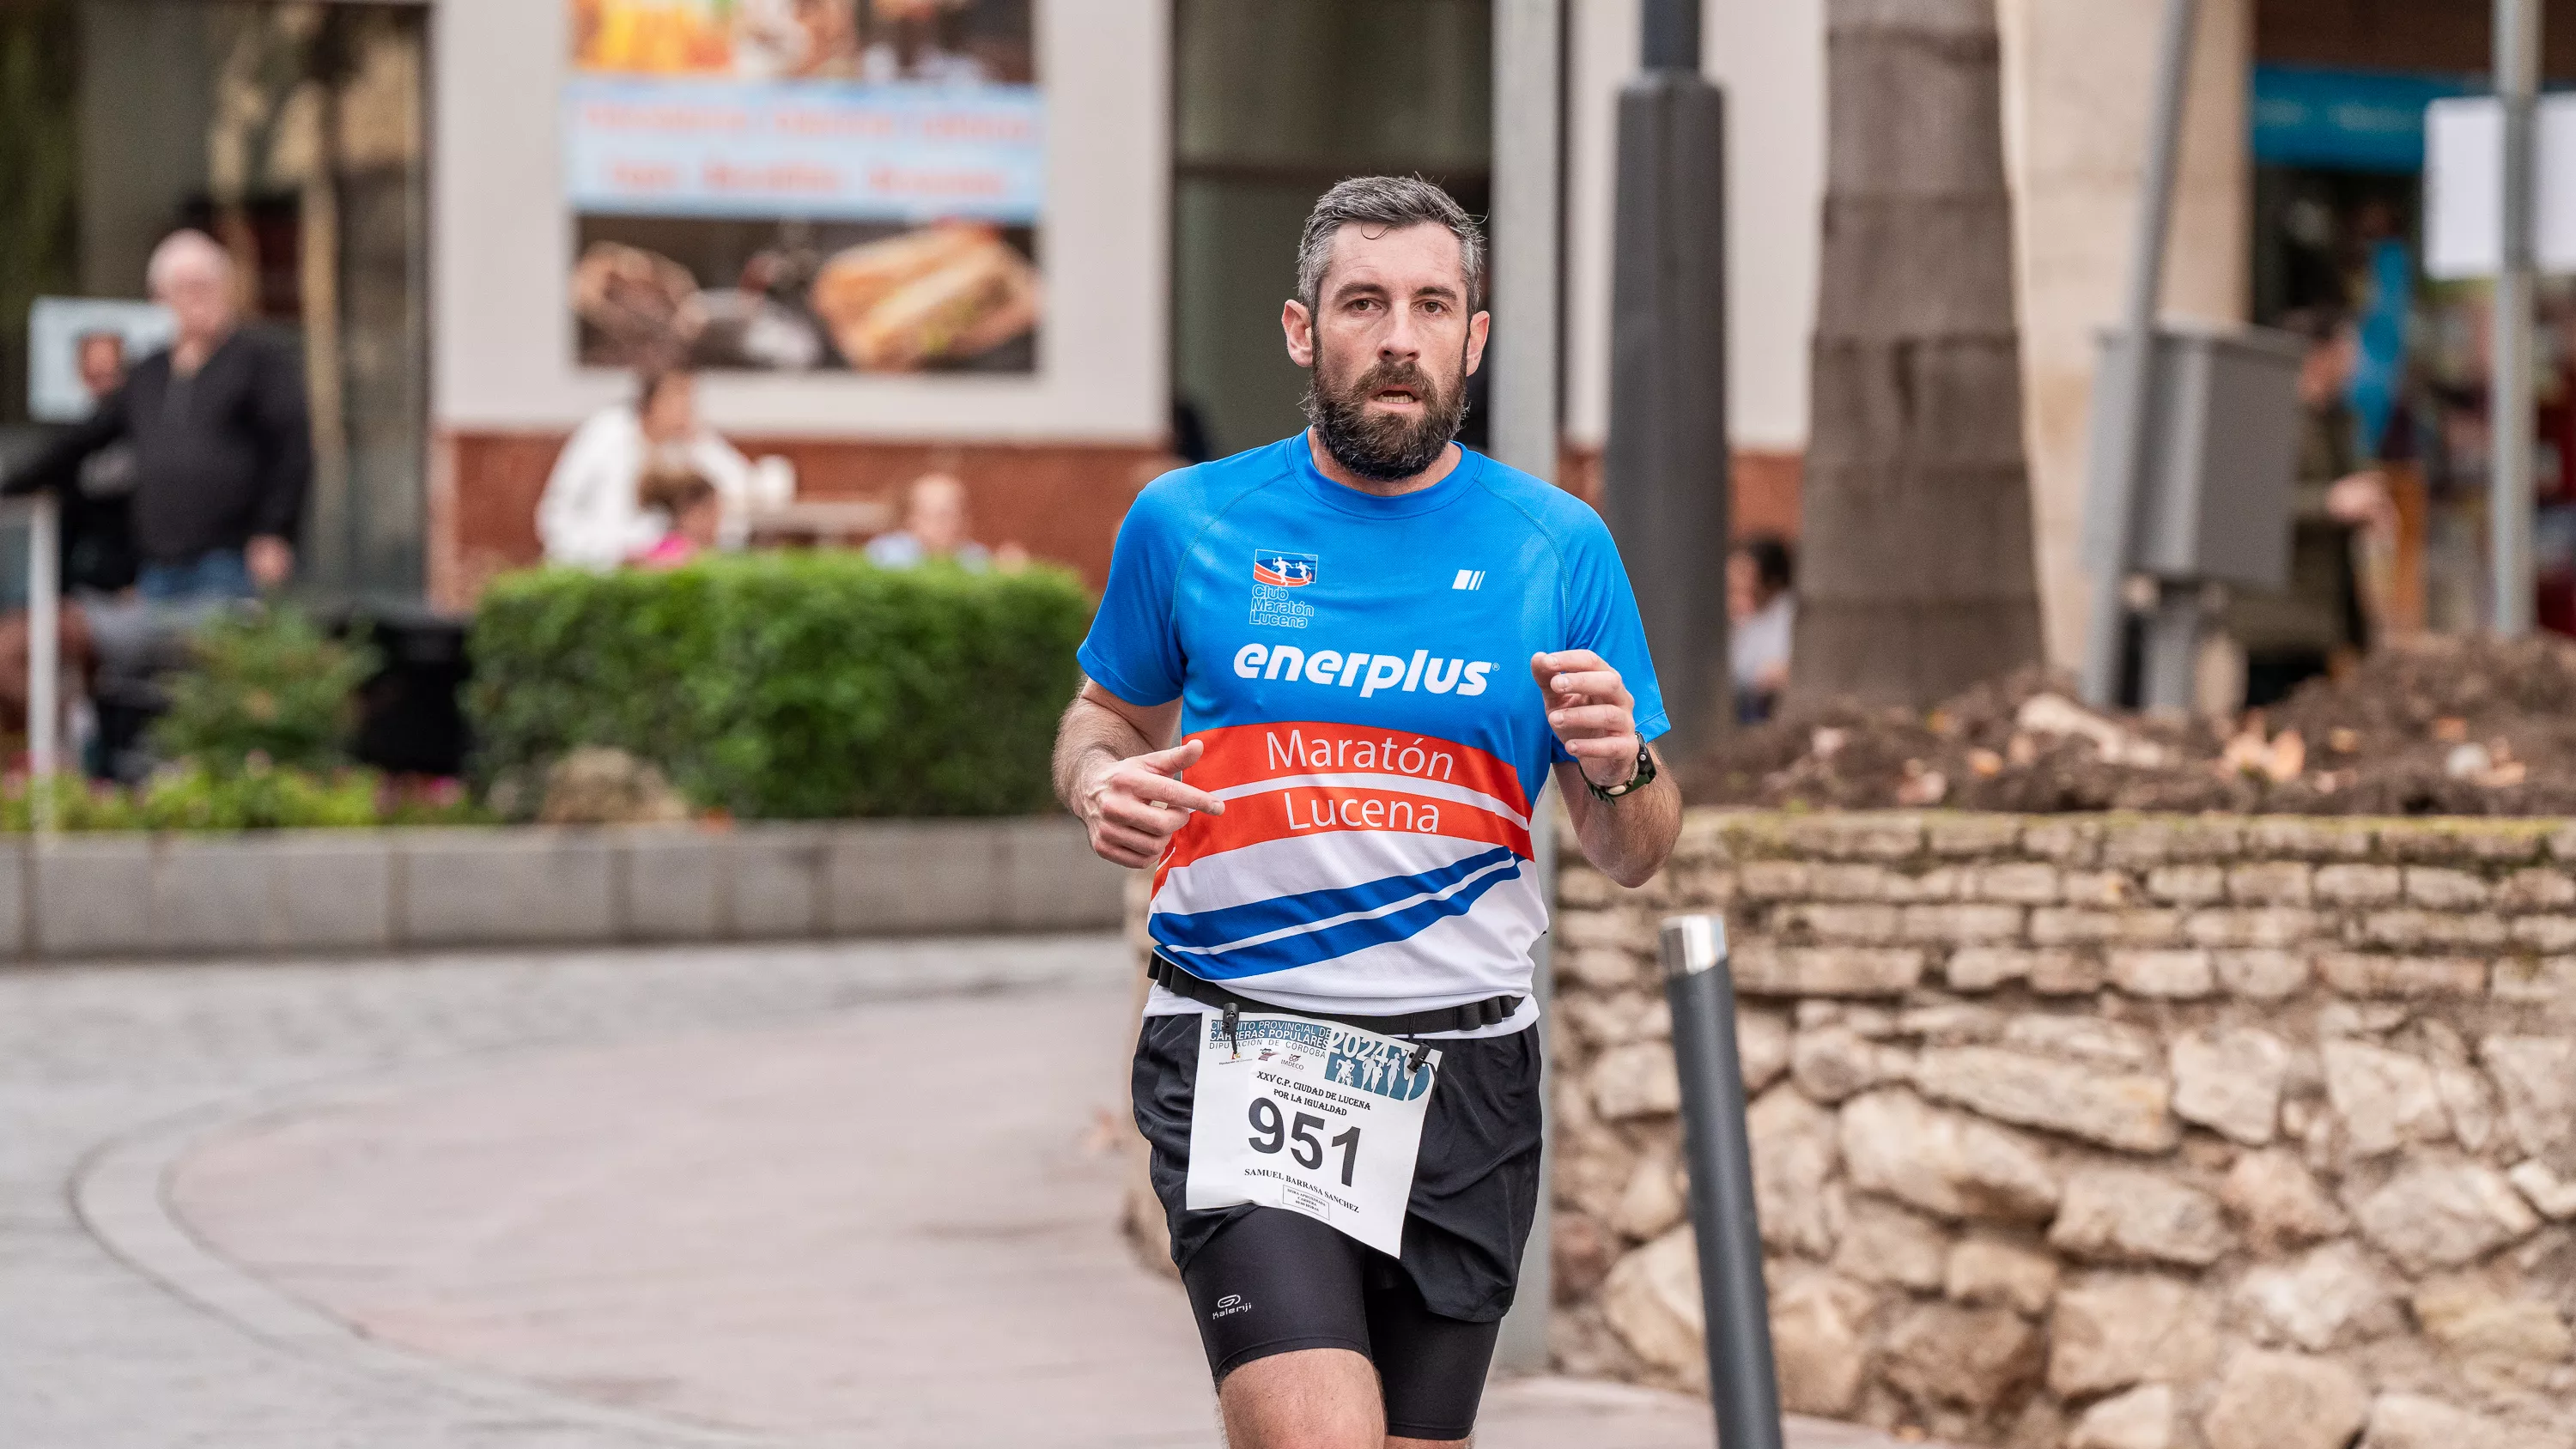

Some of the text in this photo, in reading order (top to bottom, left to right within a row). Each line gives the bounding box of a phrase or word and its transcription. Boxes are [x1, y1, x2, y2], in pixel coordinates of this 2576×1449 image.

[1250, 597, 1315, 616] Maratón
[1252, 584, 1289, 601] Club
[1249, 610, 1309, 628] Lucena
[1233, 643, 1492, 698] enerplus
[1267, 730, 1454, 780] Maratón
[1285, 792, 1440, 834] Lucena
[1258, 1021, 1315, 1035] PROVINCIAL
[1318, 1028, 1332, 1039] DE
[1268, 1029, 1329, 1050] POPULARES
[1209, 1040, 1263, 1050] DIPUACIÓN
[1285, 1041, 1326, 1058] CÓRDOBA
[1328, 1029, 1389, 1064] 2024
[1280, 1058, 1304, 1070] IMDECO
[1256, 1070, 1277, 1082] XXV
[1277, 1077, 1291, 1088] C.P.
[1293, 1082, 1324, 1097] CIUDAD
[1338, 1094, 1371, 1111] LUCENA
[1273, 1088, 1347, 1116] POR LA IGUALDAD
[1249, 1097, 1361, 1187] 951
[1244, 1168, 1359, 1213] SAMUEL BARRASA SANCHEZ
